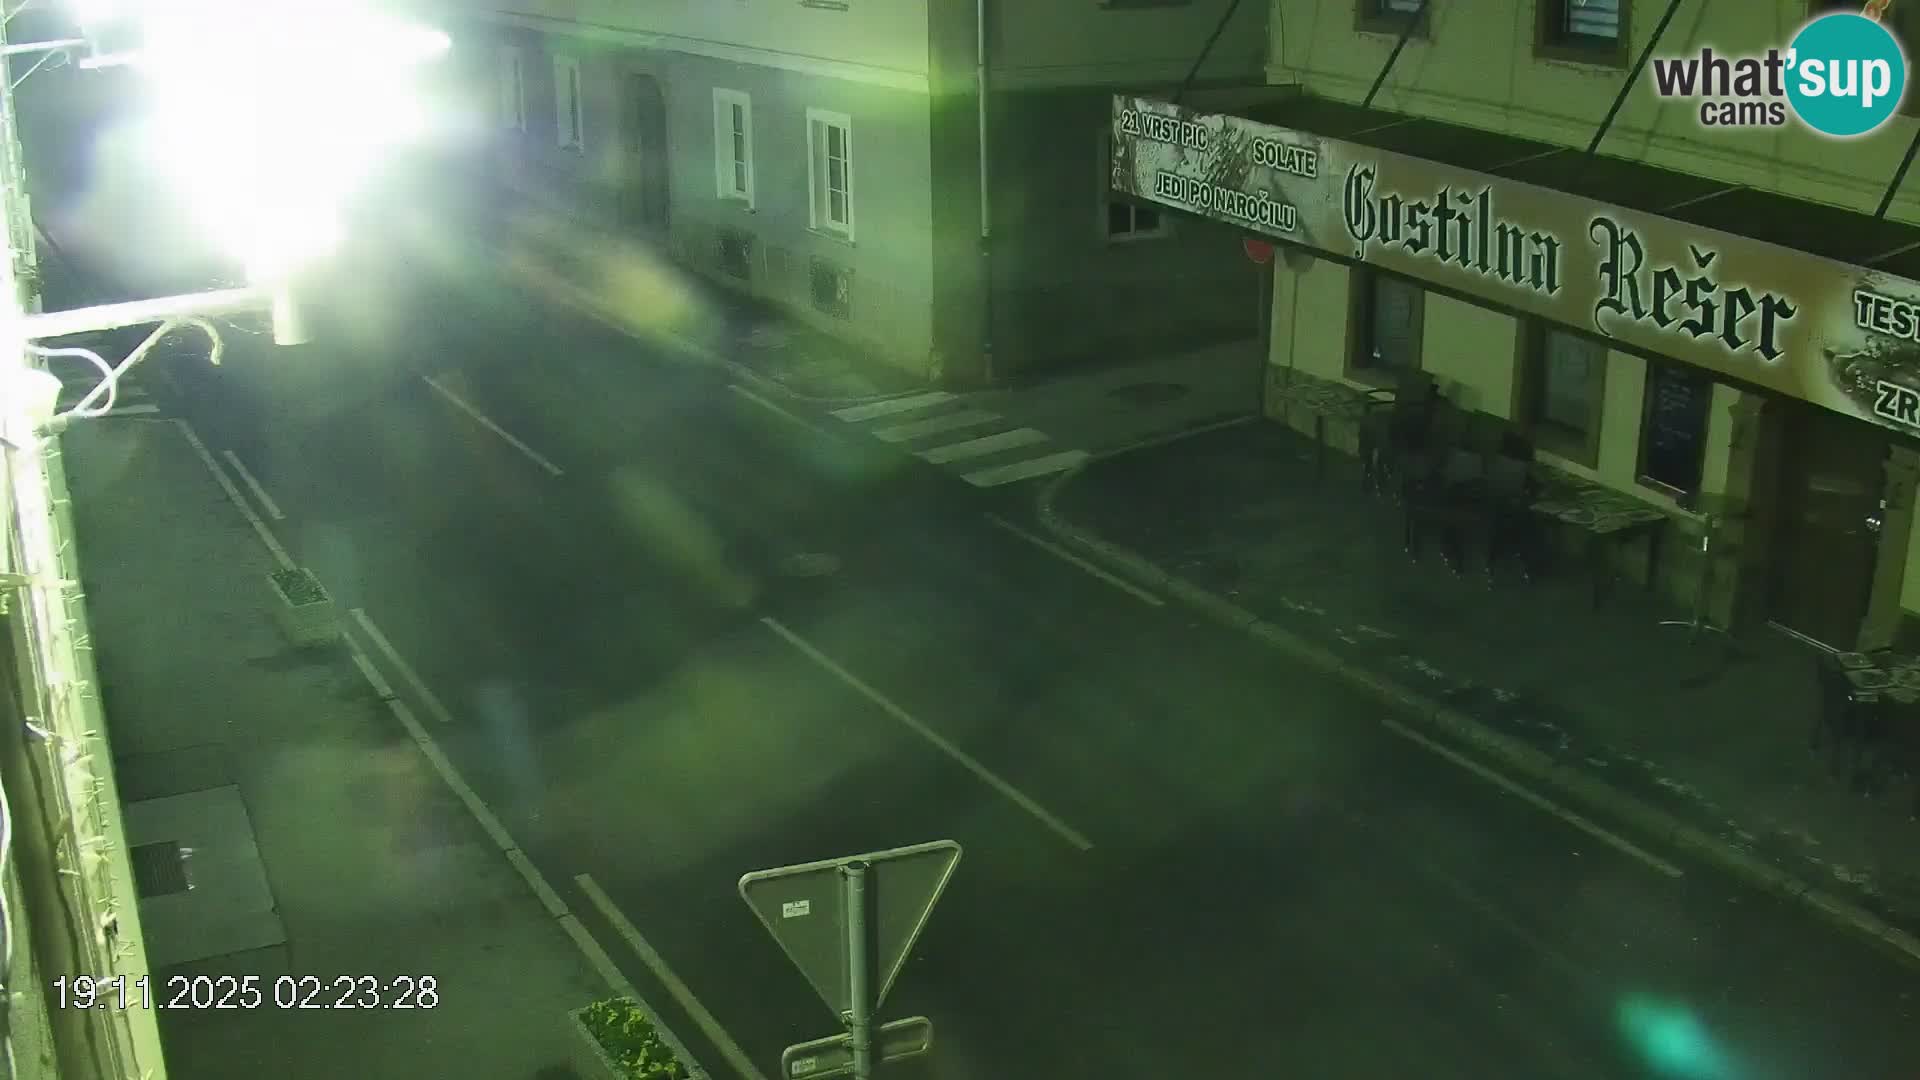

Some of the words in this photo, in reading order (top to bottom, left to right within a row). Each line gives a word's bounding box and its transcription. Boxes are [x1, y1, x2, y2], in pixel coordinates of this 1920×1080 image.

[1121, 110, 1140, 134] 21
[1142, 114, 1181, 144] VRST
[1181, 121, 1208, 150] PIC
[1252, 138, 1317, 177] SOLATE
[1155, 172, 1187, 201] JEDI
[1188, 179, 1212, 207] PO
[1213, 186, 1296, 231] NAROČILU
[1344, 161, 1562, 296] Gostilna
[1590, 216, 1798, 362] Rešer
